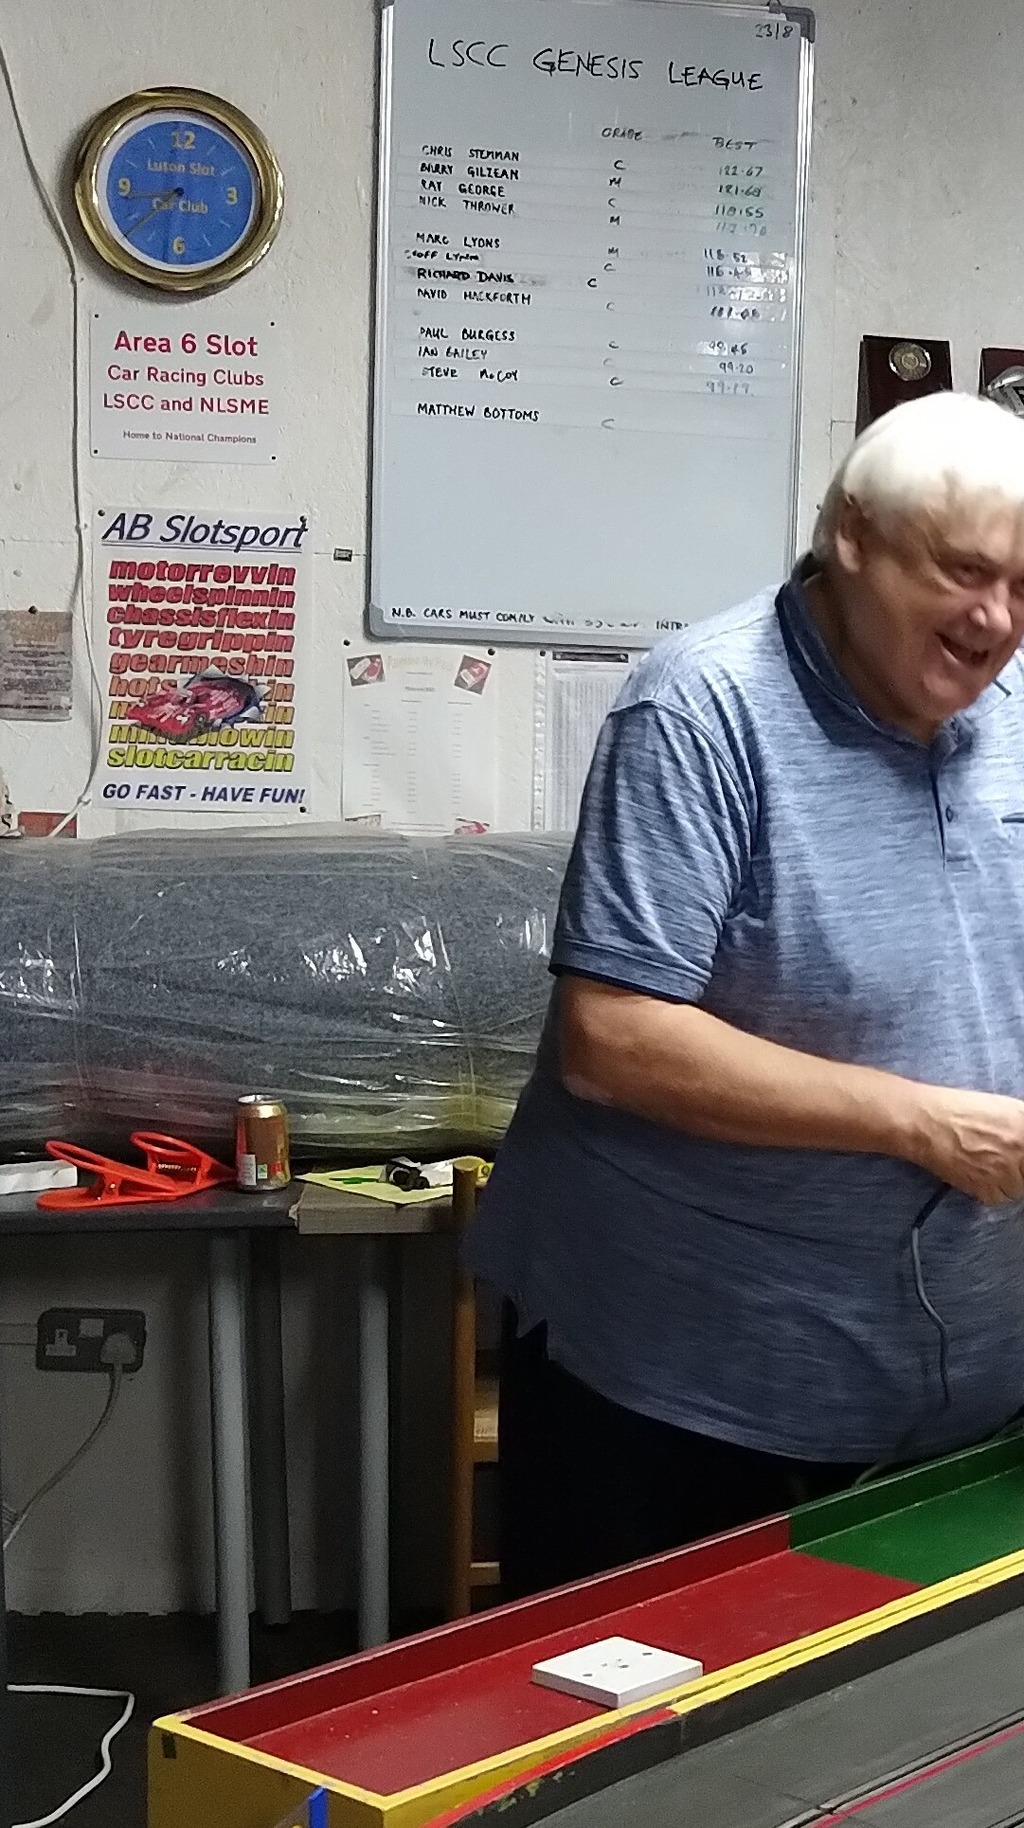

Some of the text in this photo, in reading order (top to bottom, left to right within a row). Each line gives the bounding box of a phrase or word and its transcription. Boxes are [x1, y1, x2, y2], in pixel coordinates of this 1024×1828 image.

[428, 38, 763, 91] LSCC GENESIS LEAGUE
[171, 130, 196, 150] 12
[422, 145, 452, 158] CHRIS
[614, 160, 626, 170] C
[147, 159, 215, 177] Luton Slot
[118, 177, 131, 196] 9
[458, 183, 506, 198] GEORGE
[609, 177, 622, 188] M
[226, 186, 238, 205] 3
[178, 198, 209, 215] Club
[419, 195, 447, 208] NICK
[610, 216, 621, 225] M
[172, 236, 186, 255] 6
[416, 232, 449, 245] MARC
[463, 236, 500, 249] LYONS
[417, 267, 471, 281] RICHARD
[587, 278, 597, 288] C
[114, 330, 259, 357] Area 6 Slot
[420, 327, 448, 339] PAUL
[461, 328, 516, 342] BURGESS
[418, 346, 438, 357] IAN
[107, 364, 265, 387] Car Racing Clubs
[421, 366, 459, 378] STEVE
[103, 393, 270, 415] LSCC and NLSME
[417, 403, 475, 417] MATTHEW
[483, 407, 540, 422] BOTTOMS
[122, 429, 257, 444] Home to National Champions
[101, 512, 309, 553] AB Slotsport
[108, 560, 296, 586] motorrevvin
[107, 582, 296, 609] wheelspinnin
[106, 603, 296, 631] chassisflexin
[423, 608, 453, 619] CARS
[459, 610, 491, 622] MUST
[108, 626, 295, 654] tyregrippin
[108, 652, 295, 678] gearmeshin
[106, 745, 295, 773] slotcarracin
[102, 783, 131, 800] GO
[136, 784, 186, 801] FAST
[201, 786, 255, 803] HAVE
[259, 788, 306, 804] FUN!
